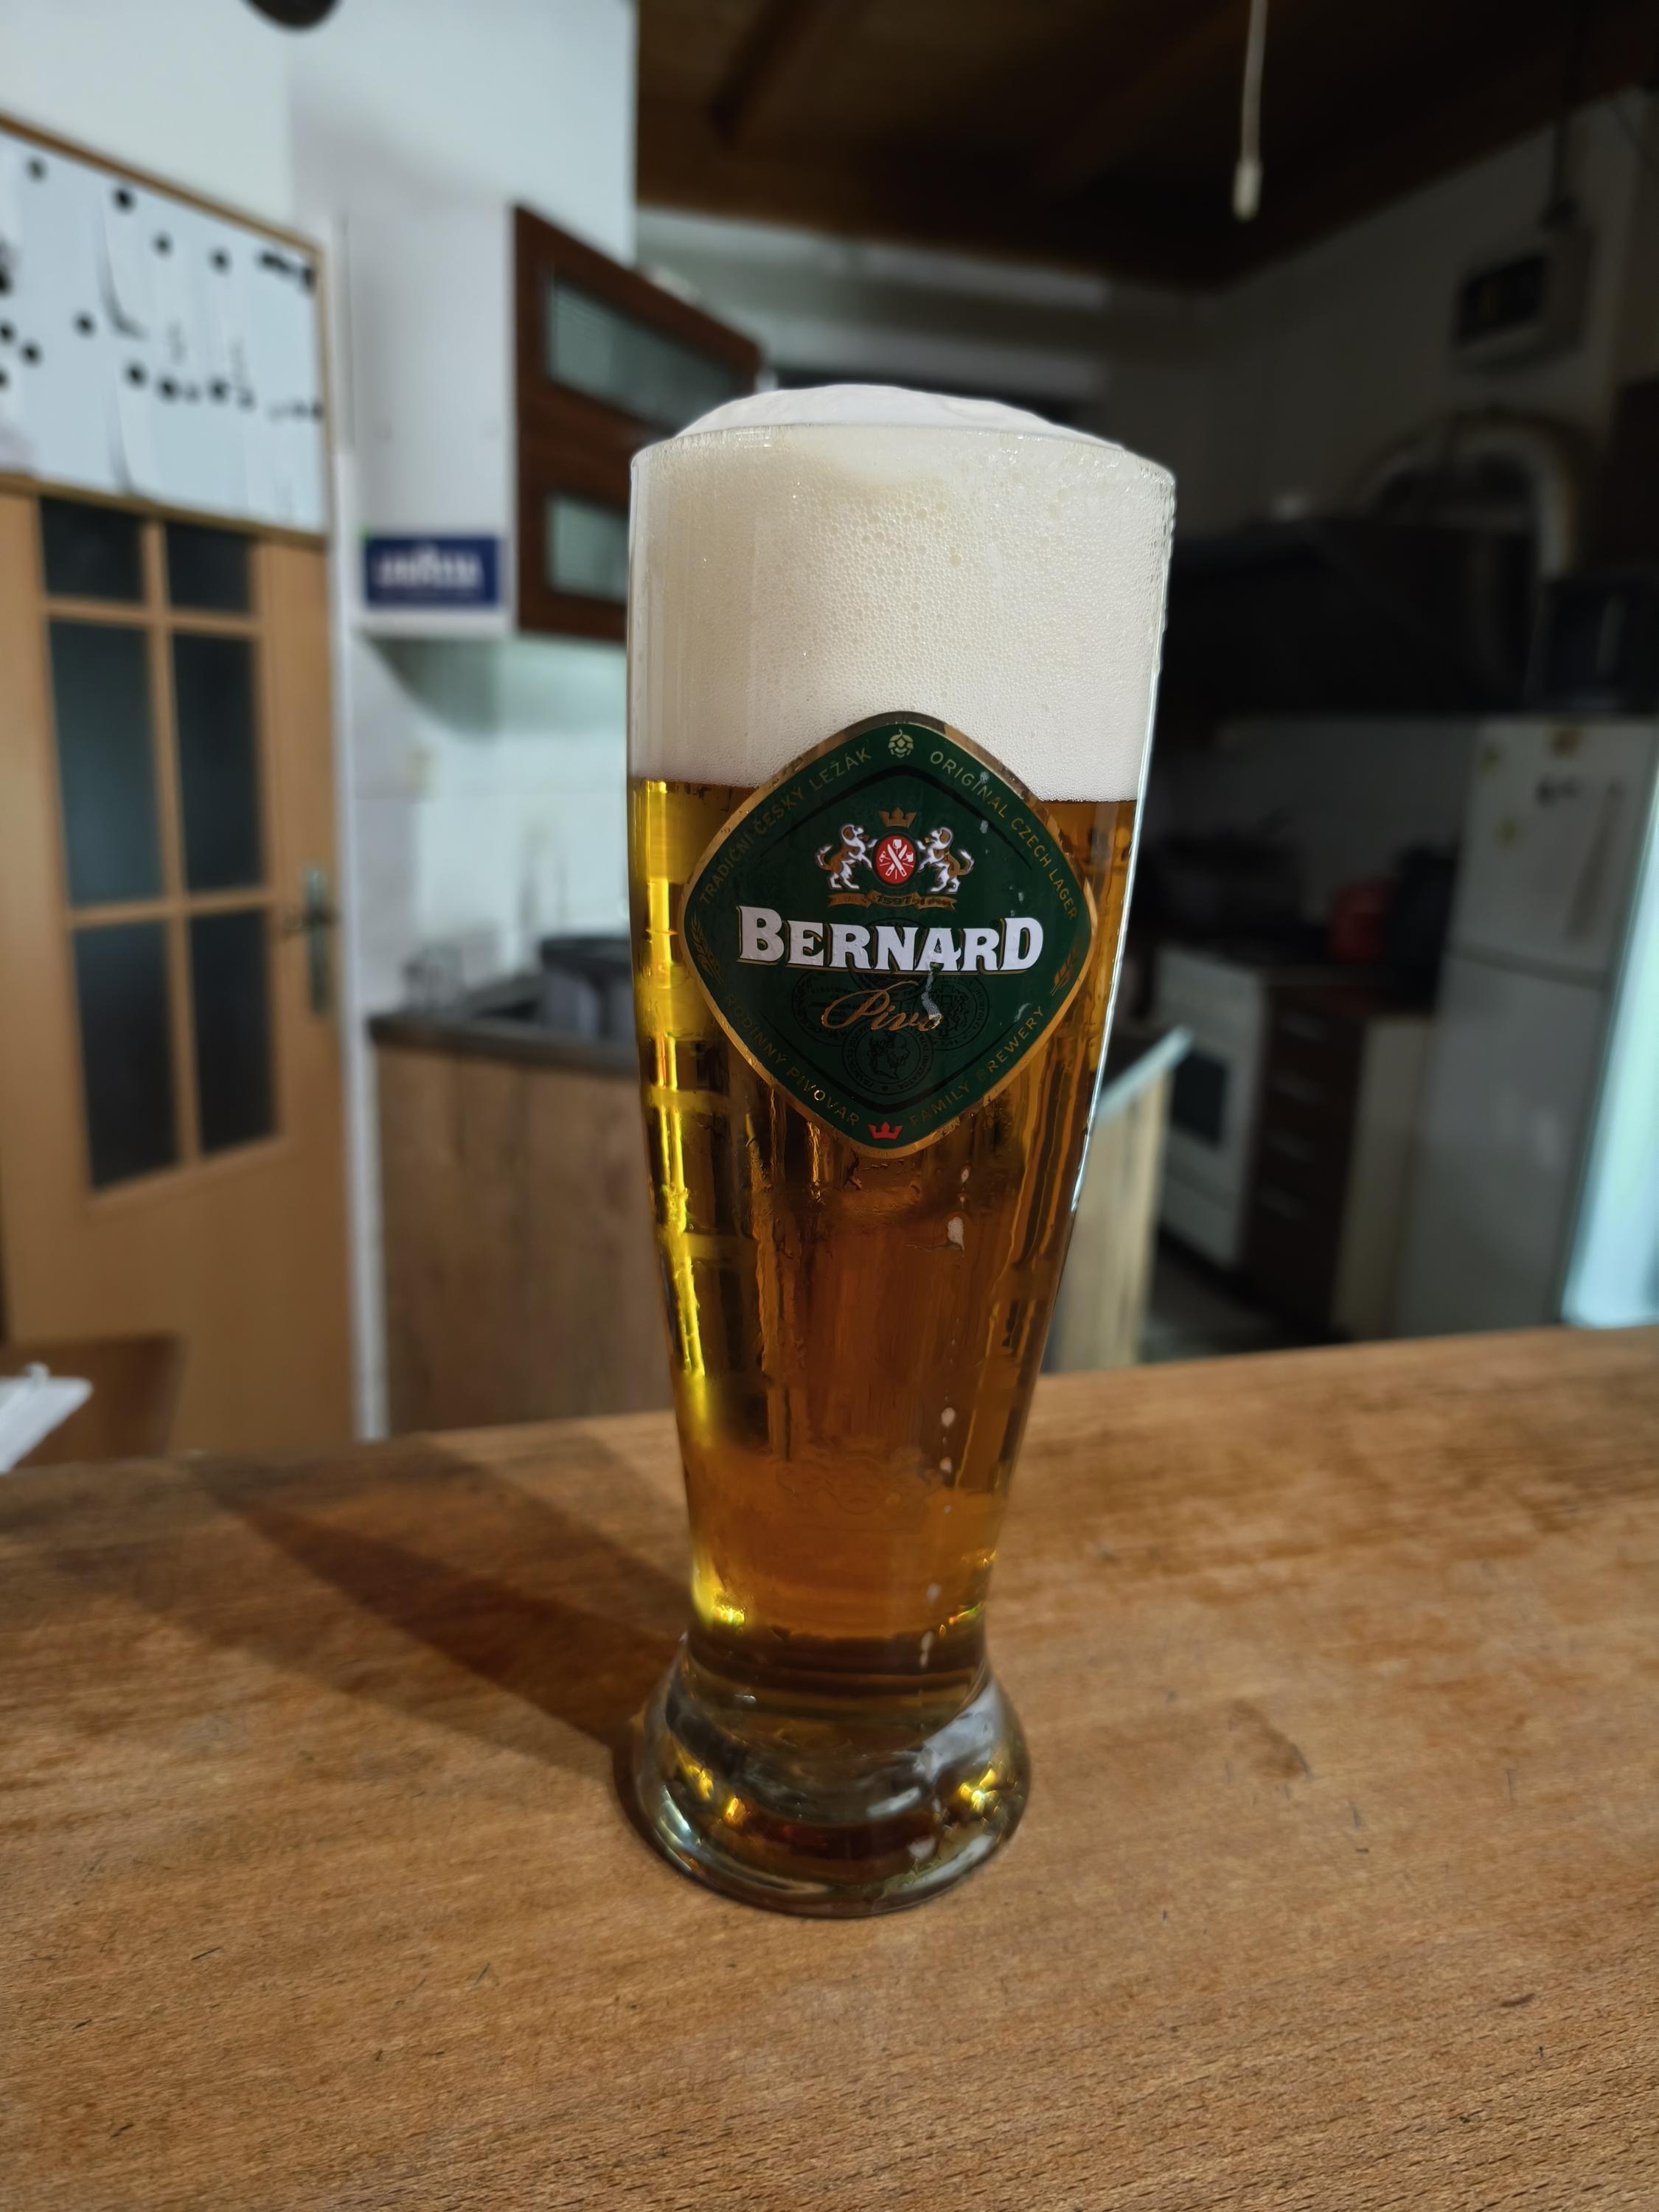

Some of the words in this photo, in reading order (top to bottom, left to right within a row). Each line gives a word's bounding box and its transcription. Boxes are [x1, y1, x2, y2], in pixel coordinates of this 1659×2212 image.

[809, 747, 872, 791] LEŽÁK
[930, 751, 1009, 818] ORIGINAL
[1011, 817, 1053, 868] CZECH
[1048, 868, 1079, 919] LAGER
[737, 906, 1044, 974] BERNARD
[785, 1066, 862, 1127] PIVOVAR
[909, 1081, 970, 1127] FAMILY
[976, 1006, 1044, 1082] BREWERY
